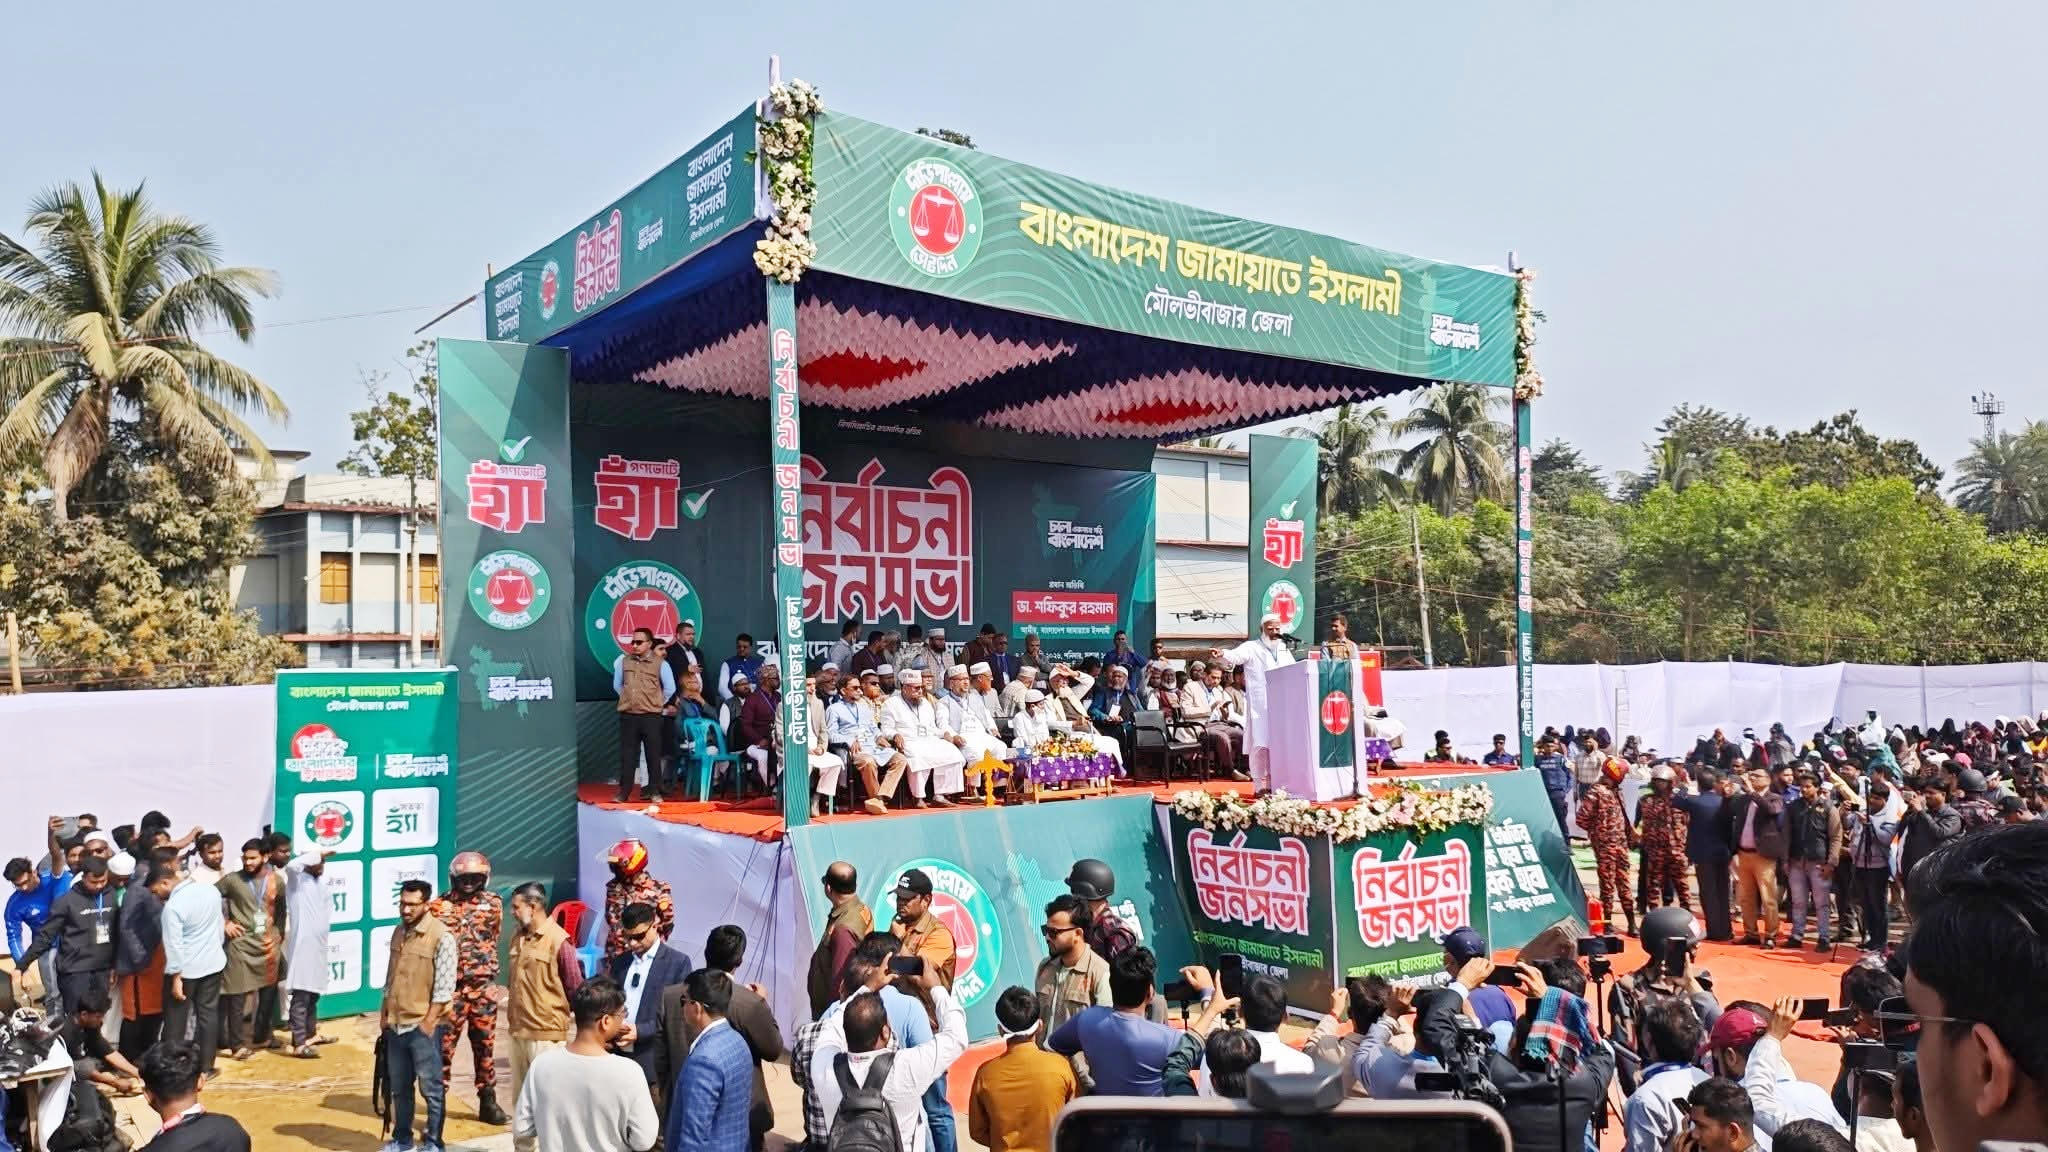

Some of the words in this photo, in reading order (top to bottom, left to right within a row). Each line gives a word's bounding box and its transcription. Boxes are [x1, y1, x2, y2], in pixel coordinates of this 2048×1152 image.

[686, 157, 733, 202] জামায়াতে
[687, 132, 734, 178] বাংলাদেশ
[689, 182, 727, 227] ইসলামী
[574, 208, 623, 281] নির্বাচনী
[1019, 200, 1170, 273] বাংলাদেশ
[1176, 237, 1302, 297] জামায়াতে
[1307, 255, 1403, 317] ইসলামী
[573, 258, 622, 313] জনসভা
[1143, 284, 1246, 331] মৌলভীবাজার
[1251, 310, 1294, 339] জেলা
[773, 328, 799, 450] নির্বাচনী
[594, 454, 681, 541] হ্যাঁ
[776, 463, 804, 568] জনসভা
[1047, 532, 1104, 550] বাংলাদেশ
[785, 595, 803, 638] জেলা
[1016, 600, 1032, 614] ডা.
[1034, 596, 1077, 619] শফিকুর
[1079, 601, 1114, 615] রহমান
[786, 643, 807, 745] মৌলভীবাজার
[1188, 827, 1310, 898] নির্বাচনী
[1352, 838, 1471, 911] নির্বাচনী
[1197, 880, 1309, 936] জনসভা
[1359, 893, 1470, 948] জনসভা
[1192, 930, 1237, 950] বাংলাদেশ
[1237, 938, 1282, 960] জামায়াতে
[1282, 943, 1324, 969] ইসলামী
[1348, 960, 1398, 977] বাংলাদেশ
